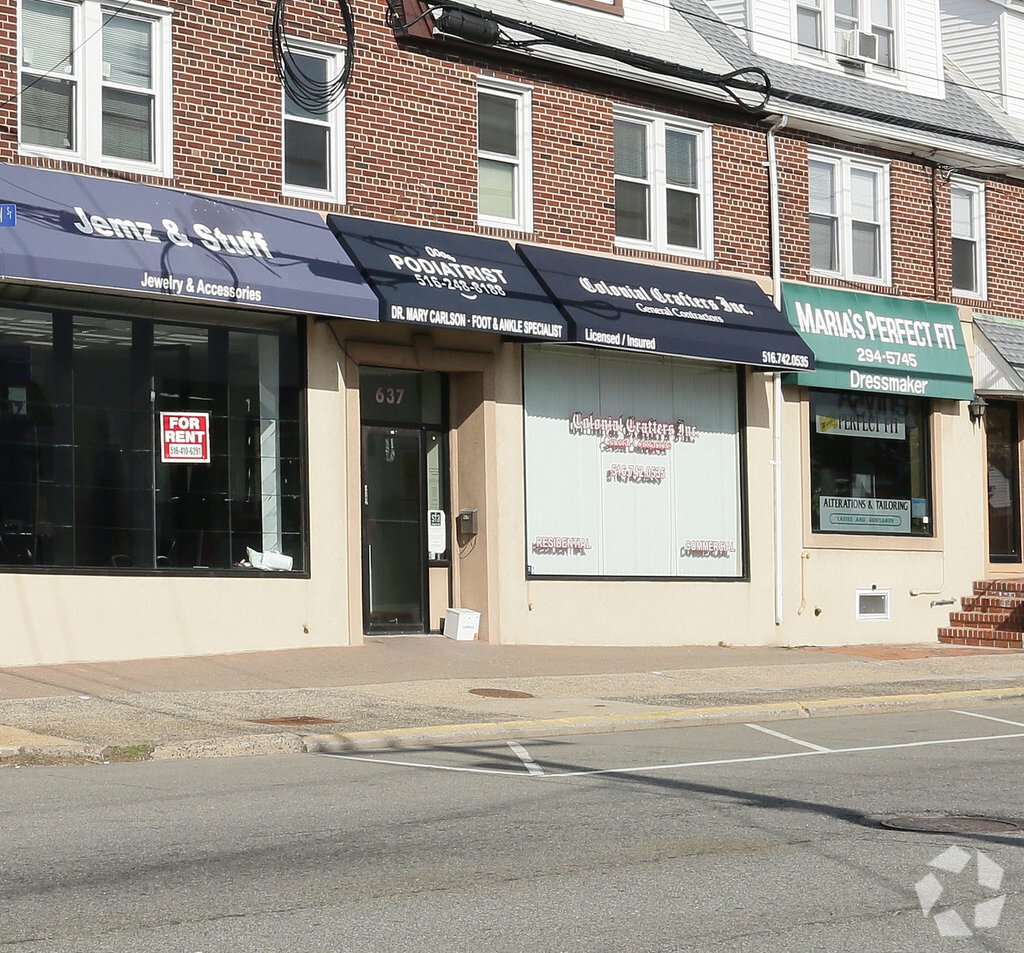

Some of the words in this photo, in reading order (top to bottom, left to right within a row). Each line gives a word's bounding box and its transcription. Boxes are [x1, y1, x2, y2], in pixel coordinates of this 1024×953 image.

[73, 207, 162, 244] Jemz
[161, 219, 194, 248] &
[193, 223, 275, 259] Stuff
[388, 253, 508, 285] PODIATRIST
[140, 271, 183, 294] Jewelry
[186, 277, 195, 293] &
[196, 279, 262, 302] Accessories
[414, 273, 507, 297] 516-248-8188
[578, 276, 652, 302] Colonial
[649, 287, 718, 312] Crafters
[715, 296, 754, 316] Inc.
[391, 305, 405, 321] DR.
[406, 307, 429, 323] MARY
[429, 310, 466, 328] CARLSON
[471, 315, 492, 331] FOOT
[492, 317, 499, 331] &
[499, 318, 523, 334] ANKLE
[523, 321, 563, 339] SPECIALIST
[635, 302, 674, 318] General
[673, 307, 725, 324] Contractors
[794, 301, 867, 340] MARIA'S
[864, 310, 934, 348] PERFECT
[933, 322, 958, 350] FIT
[584, 328, 621, 346] Licensed
[626, 334, 656, 350] Insured
[761, 350, 809, 368] 516.742.0535
[856, 347, 918, 368] 294-5745
[849, 369, 929, 395] Dressmaker
[375, 387, 405, 405] 637
[169, 416, 200, 430] FOR
[570, 411, 626, 435] Colonial
[838, 413, 881, 433] PERFECT
[164, 430, 206, 444] RENT
[823, 498, 867, 510] ALTERATIONS
[867, 500, 874, 510] &
[875, 500, 909, 511] TAILORING
[535, 536, 592, 550] RESIDENTIAL
[684, 539, 736, 553] COMMERCIAL
